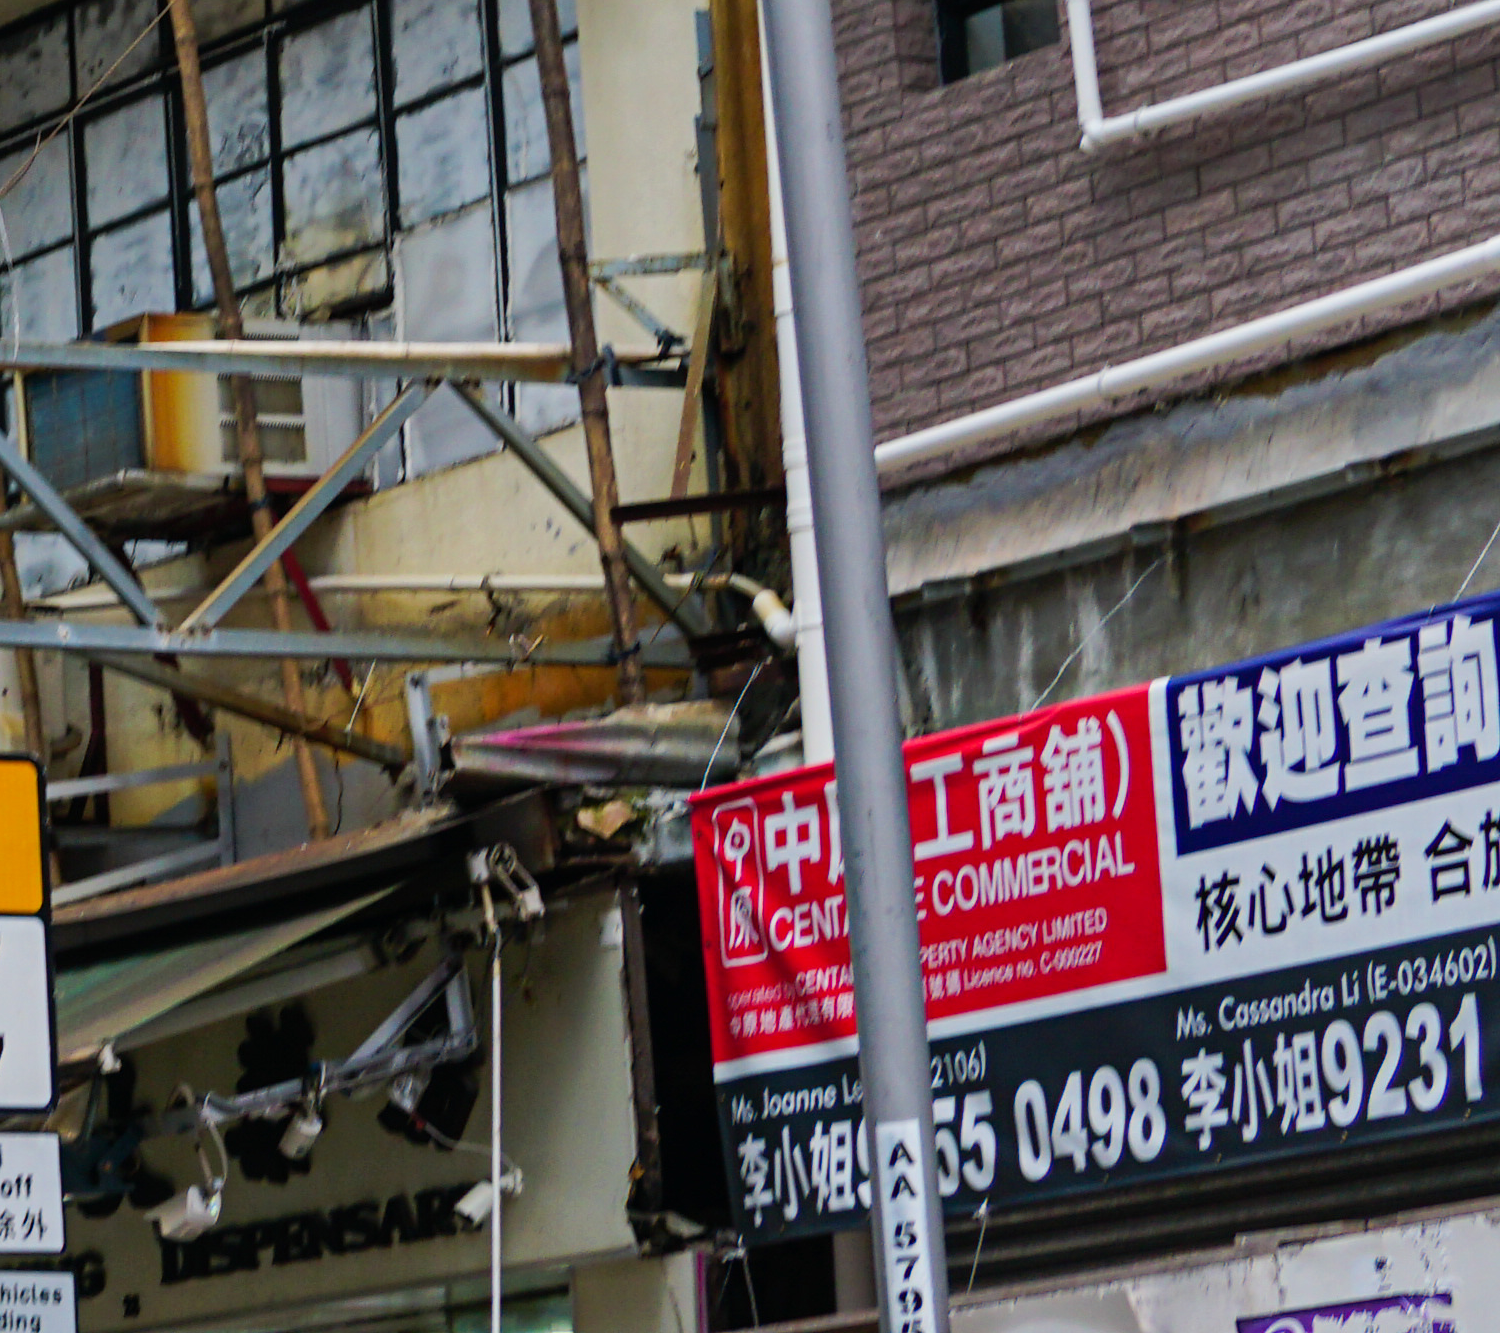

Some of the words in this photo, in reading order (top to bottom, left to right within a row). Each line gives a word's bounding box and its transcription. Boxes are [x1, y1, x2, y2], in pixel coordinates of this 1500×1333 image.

[1177, 614, 1500, 830] 歡迎查詢
[932, 830, 1136, 916] COMMERCIAL
[1195, 834, 1400, 953] 核心地帶
[972, 920, 1038, 958] AGENCY
[1043, 907, 1107, 943] LIMITED
[1176, 1006, 1213, 1041] Ms.
[1218, 979, 1334, 1031] Cassandra
[1341, 969, 1360, 1009] Li
[1367, 935, 1497, 1003] (E-034602)
[761, 1084, 837, 1120] Joanne
[931, 1040, 986, 1088] 2106)
[1014, 1057, 1167, 1182] 0498
[1, 1173, 33, 1198] off
